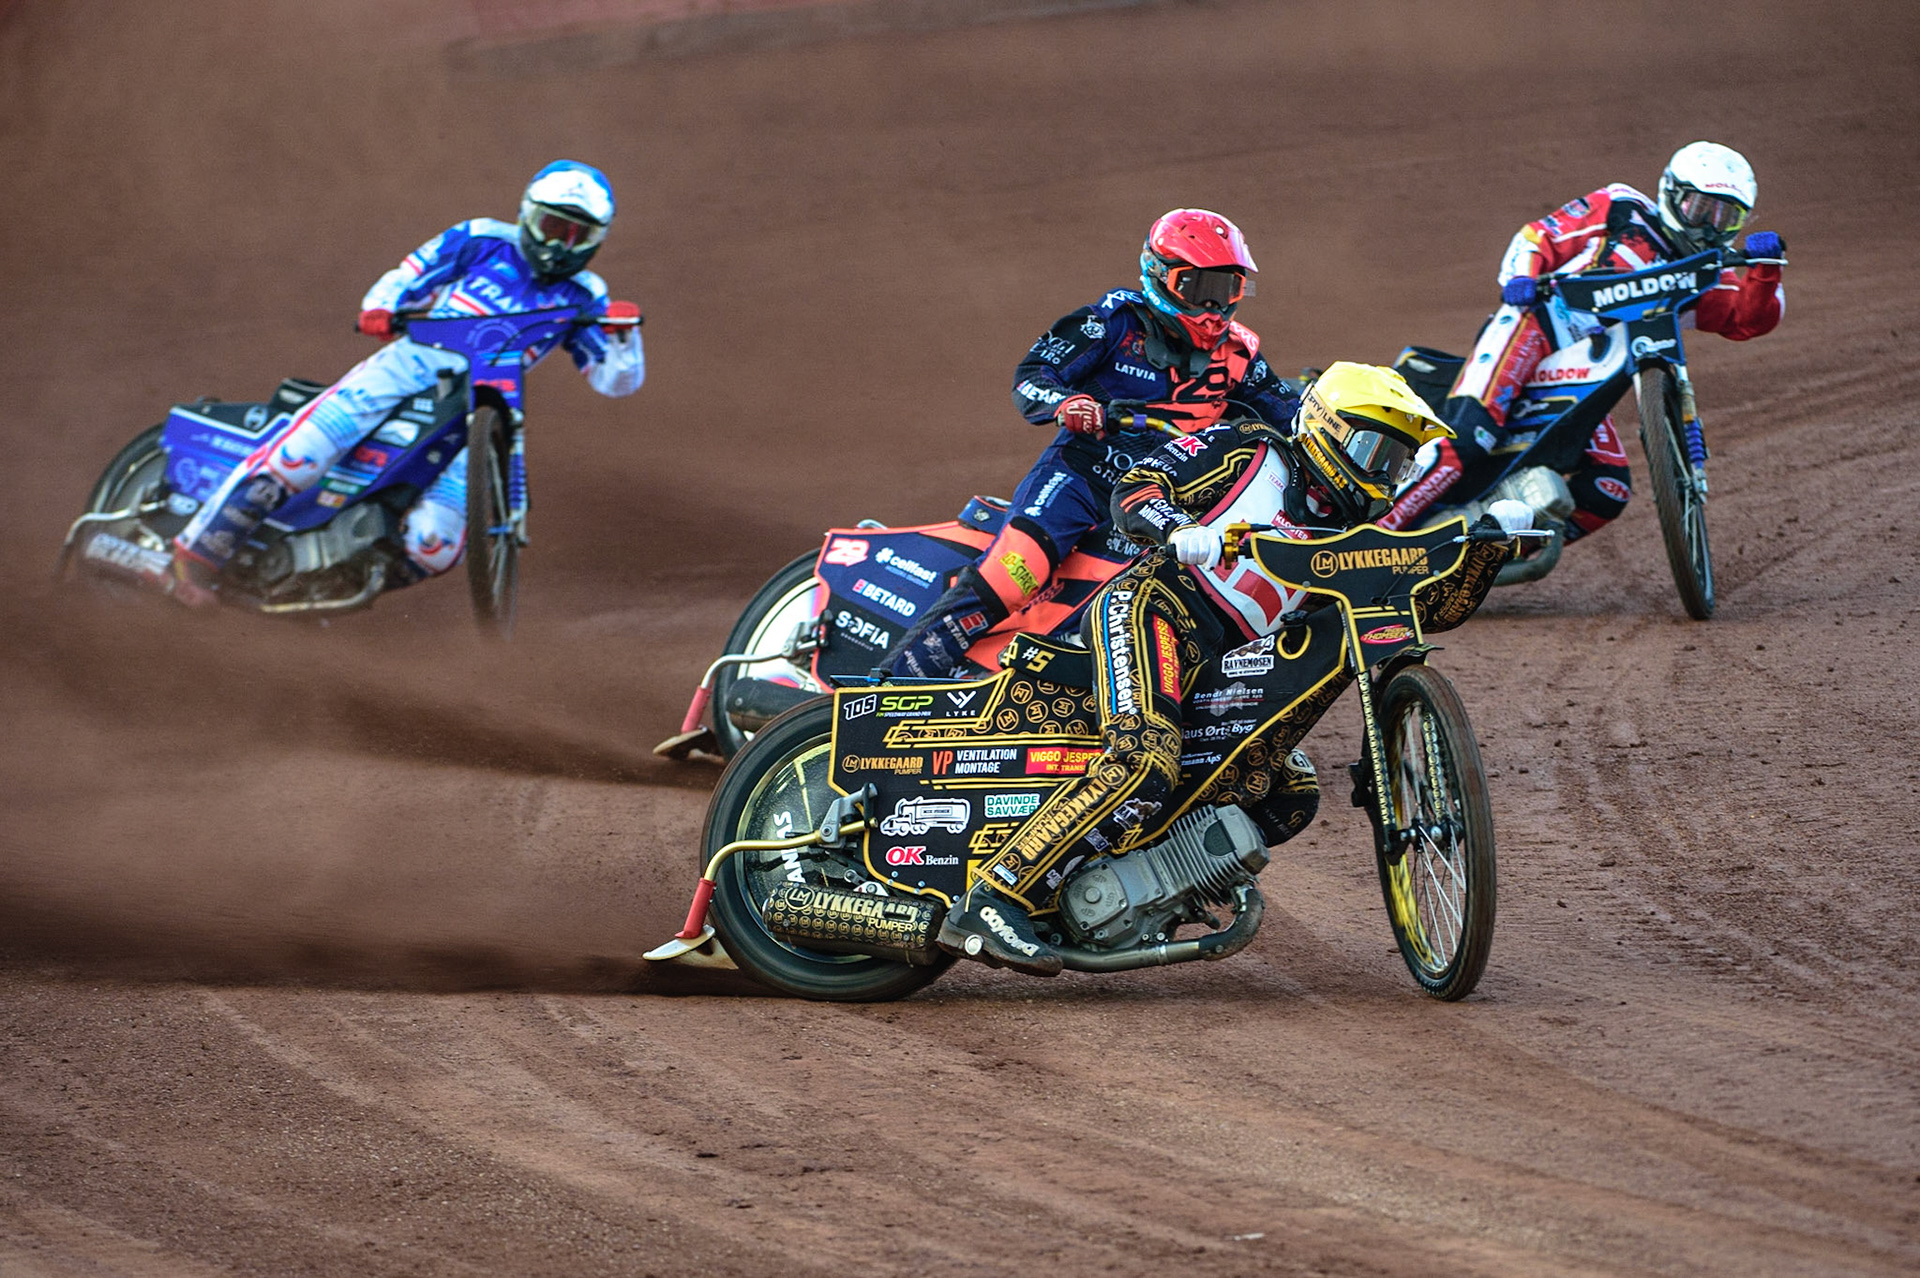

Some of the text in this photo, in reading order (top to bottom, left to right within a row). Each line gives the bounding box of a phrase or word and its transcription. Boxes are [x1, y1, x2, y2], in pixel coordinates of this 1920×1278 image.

[1592, 272, 1698, 308] MOLDOW
[1114, 361, 1156, 382] LATVIA
[1338, 547, 1429, 571] LYKKEGAARD
[862, 583, 916, 617] BETARD
[1226, 688, 1264, 696] Nielsen
[844, 694, 877, 720] 105
[880, 695, 934, 711] SGP
[860, 757, 924, 770] LYKKEGAARD
[932, 749, 1017, 775] VP VENTILATION
[1030, 751, 1062, 763] VIGGO
[955, 762, 1000, 774] MONTAGE
[1061, 764, 1086, 772] TRANS
[987, 796, 1038, 806] DAVINDE
[886, 847, 959, 866] OK Benzin
[867, 918, 914, 932] PUMPER
